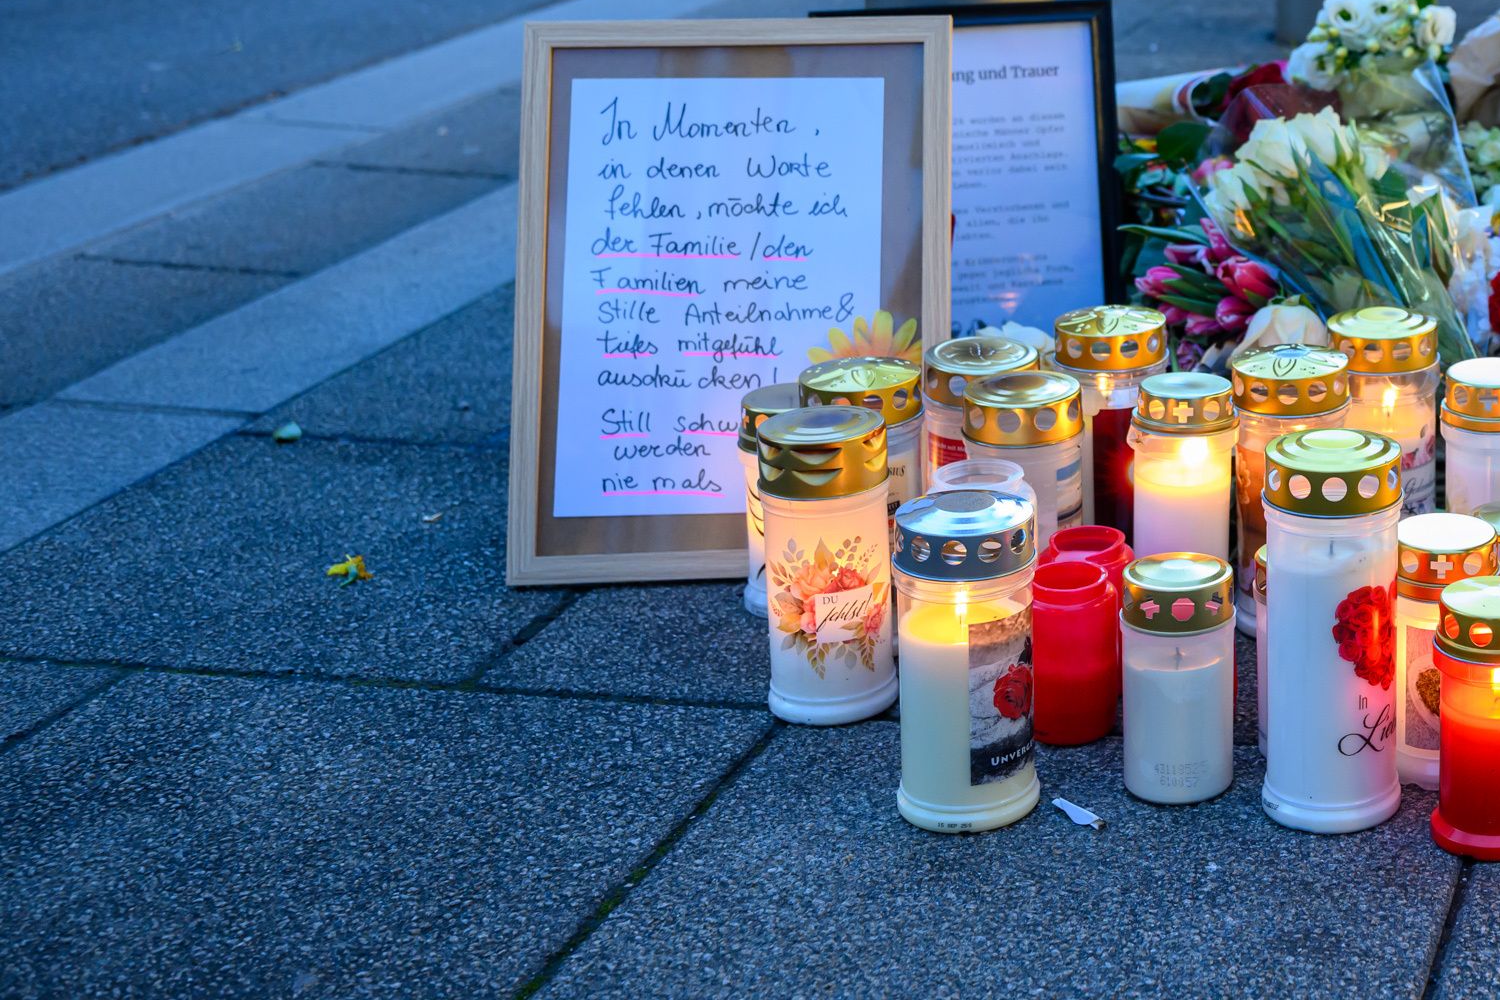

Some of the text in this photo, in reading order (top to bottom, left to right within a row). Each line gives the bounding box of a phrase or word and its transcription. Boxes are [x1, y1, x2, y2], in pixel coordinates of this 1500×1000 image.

[978, 66, 1007, 80] und
[1010, 65, 1060, 79] Trauer
[600, 96, 638, 146] In
[598, 152, 832, 179] in denen Worte
[708, 191, 799, 218] möchte
[808, 193, 848, 218] ich
[591, 227, 638, 256] der
[590, 267, 808, 295] Familien meine
[597, 301, 661, 325] Stille
[678, 333, 784, 363] mitgefühl
[601, 408, 651, 435] Still
[614, 436, 711, 460] werden
[822, 595, 838, 605] DU
[1358, 694, 1368, 711] In
